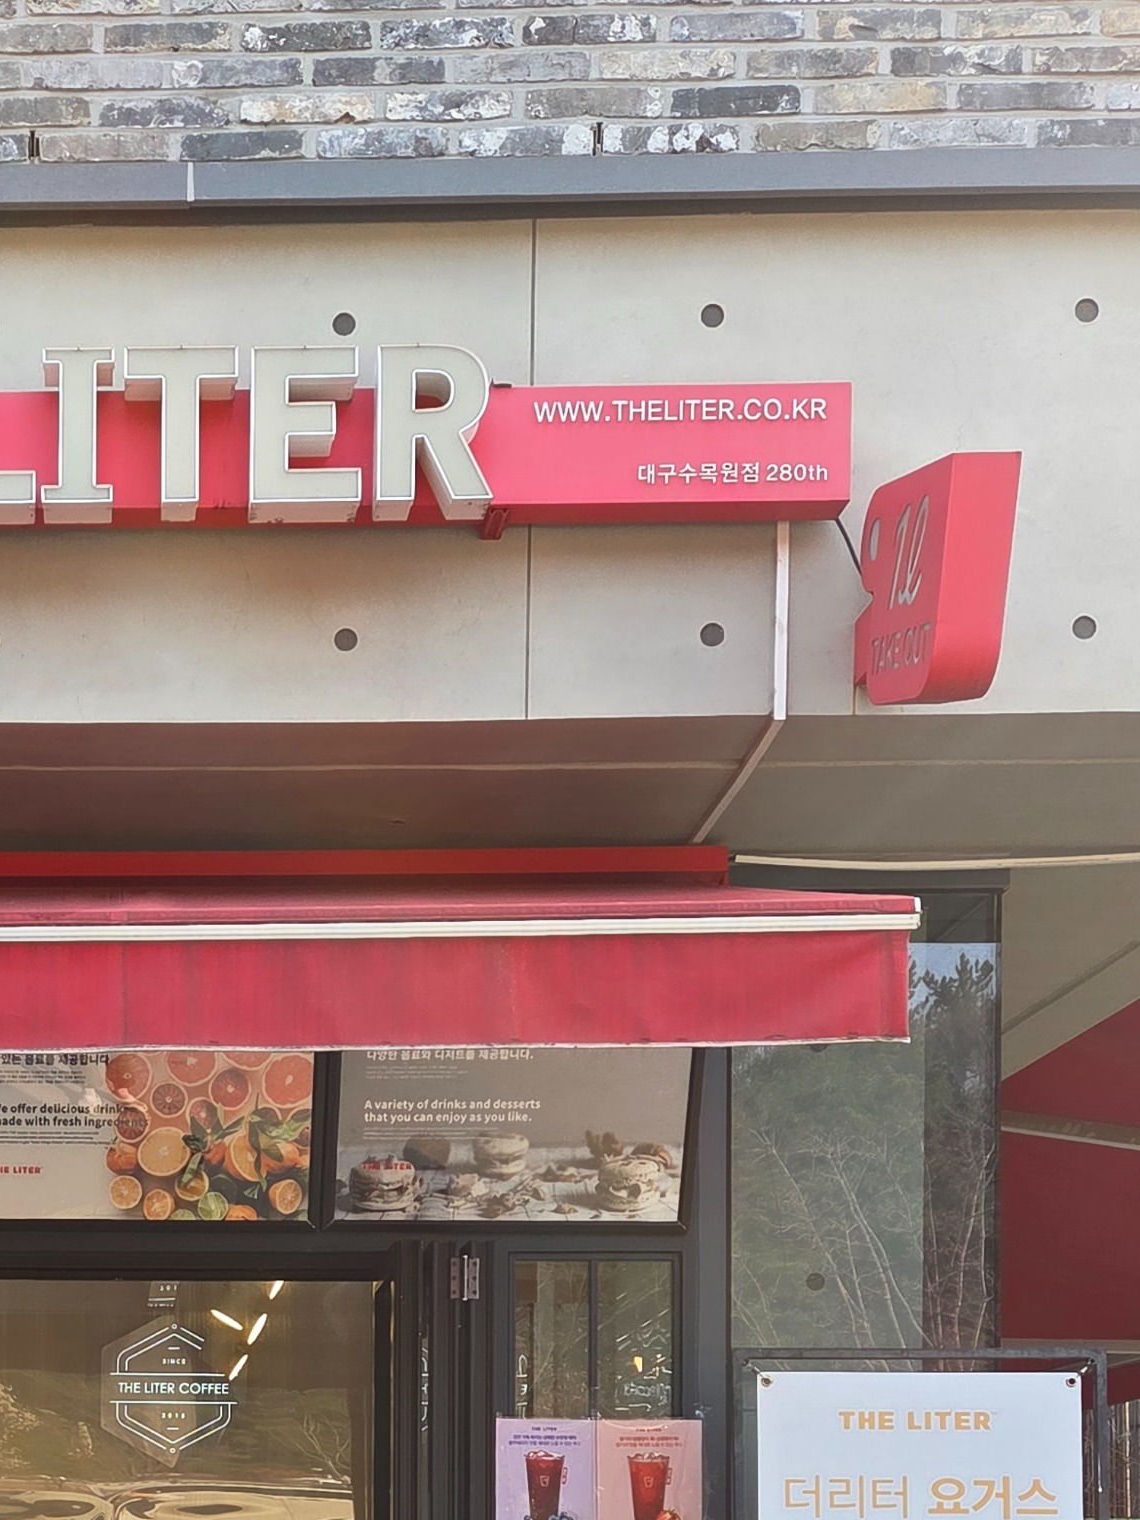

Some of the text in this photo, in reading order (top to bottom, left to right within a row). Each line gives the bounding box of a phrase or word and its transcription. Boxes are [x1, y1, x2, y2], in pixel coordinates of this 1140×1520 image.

[533, 397, 828, 423] WWW.THELITER.CO.KR
[638, 462, 828, 485] 대구수목원점 280th
[871, 622, 931, 674] TAKE OUT
[10, 1103, 38, 1114] offer
[40, 1103, 91, 1114] delicious
[364, 1099, 541, 1111] A variety of drinks and desserts
[25, 1115, 51, 1127] with
[52, 1115, 82, 1127] fresh
[364, 1112, 532, 1124] that you can enjoy as you like.
[13, 1166, 41, 1175] LITER
[162, 1358, 187, 1366] SINCE
[118, 1382, 230, 1395] THE LITER COFFEE
[839, 1411, 992, 1431] THE LITER
[784, 1475, 1058, 1520] 더리터 요거스
